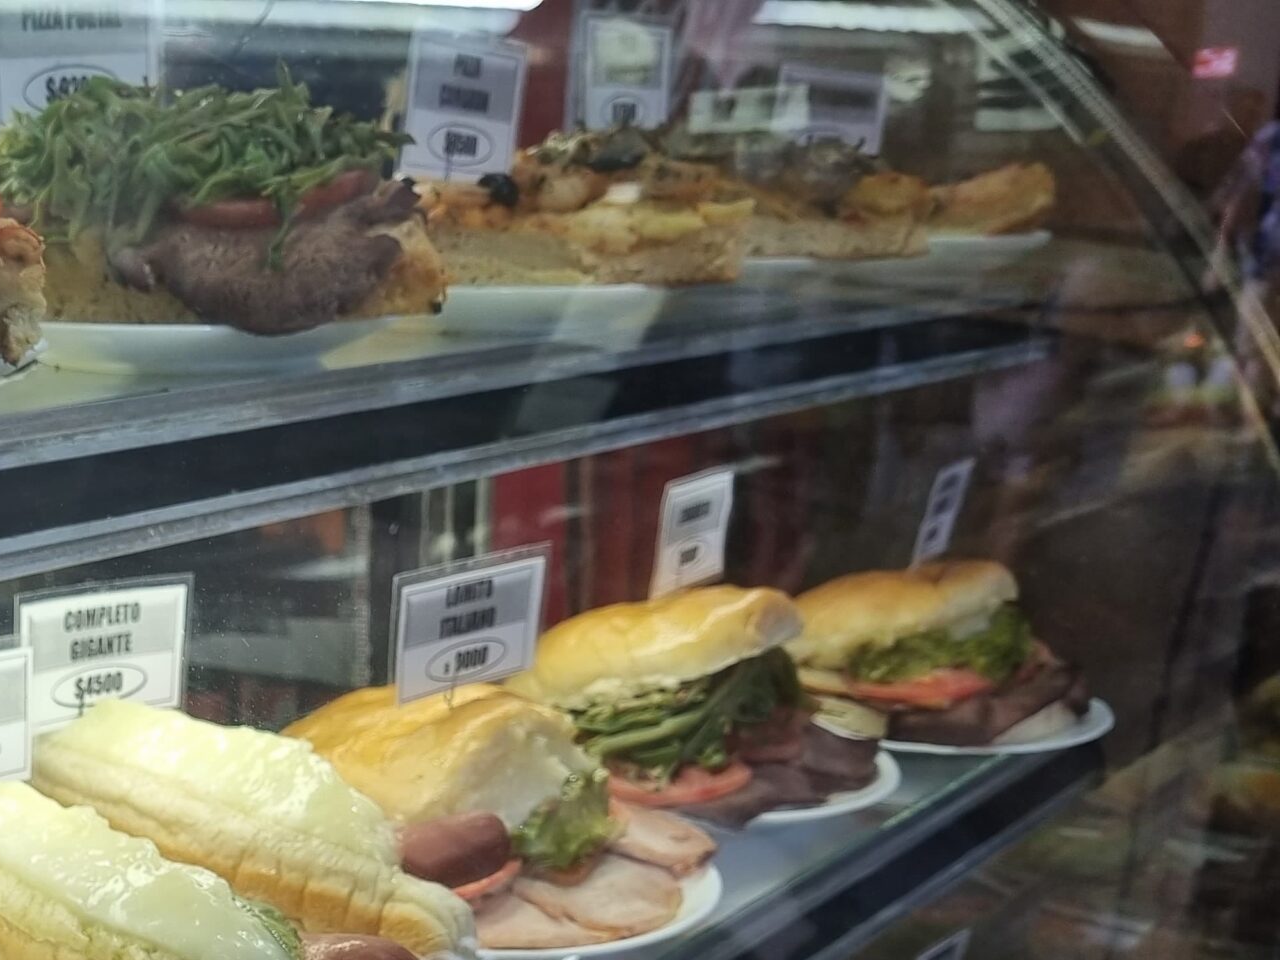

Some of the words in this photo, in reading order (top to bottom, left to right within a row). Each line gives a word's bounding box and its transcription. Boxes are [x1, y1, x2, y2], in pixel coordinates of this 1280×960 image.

[63, 602, 140, 633] COMPLETO
[70, 632, 132, 661] GIGANTE
[74, 671, 123, 700] $4500
